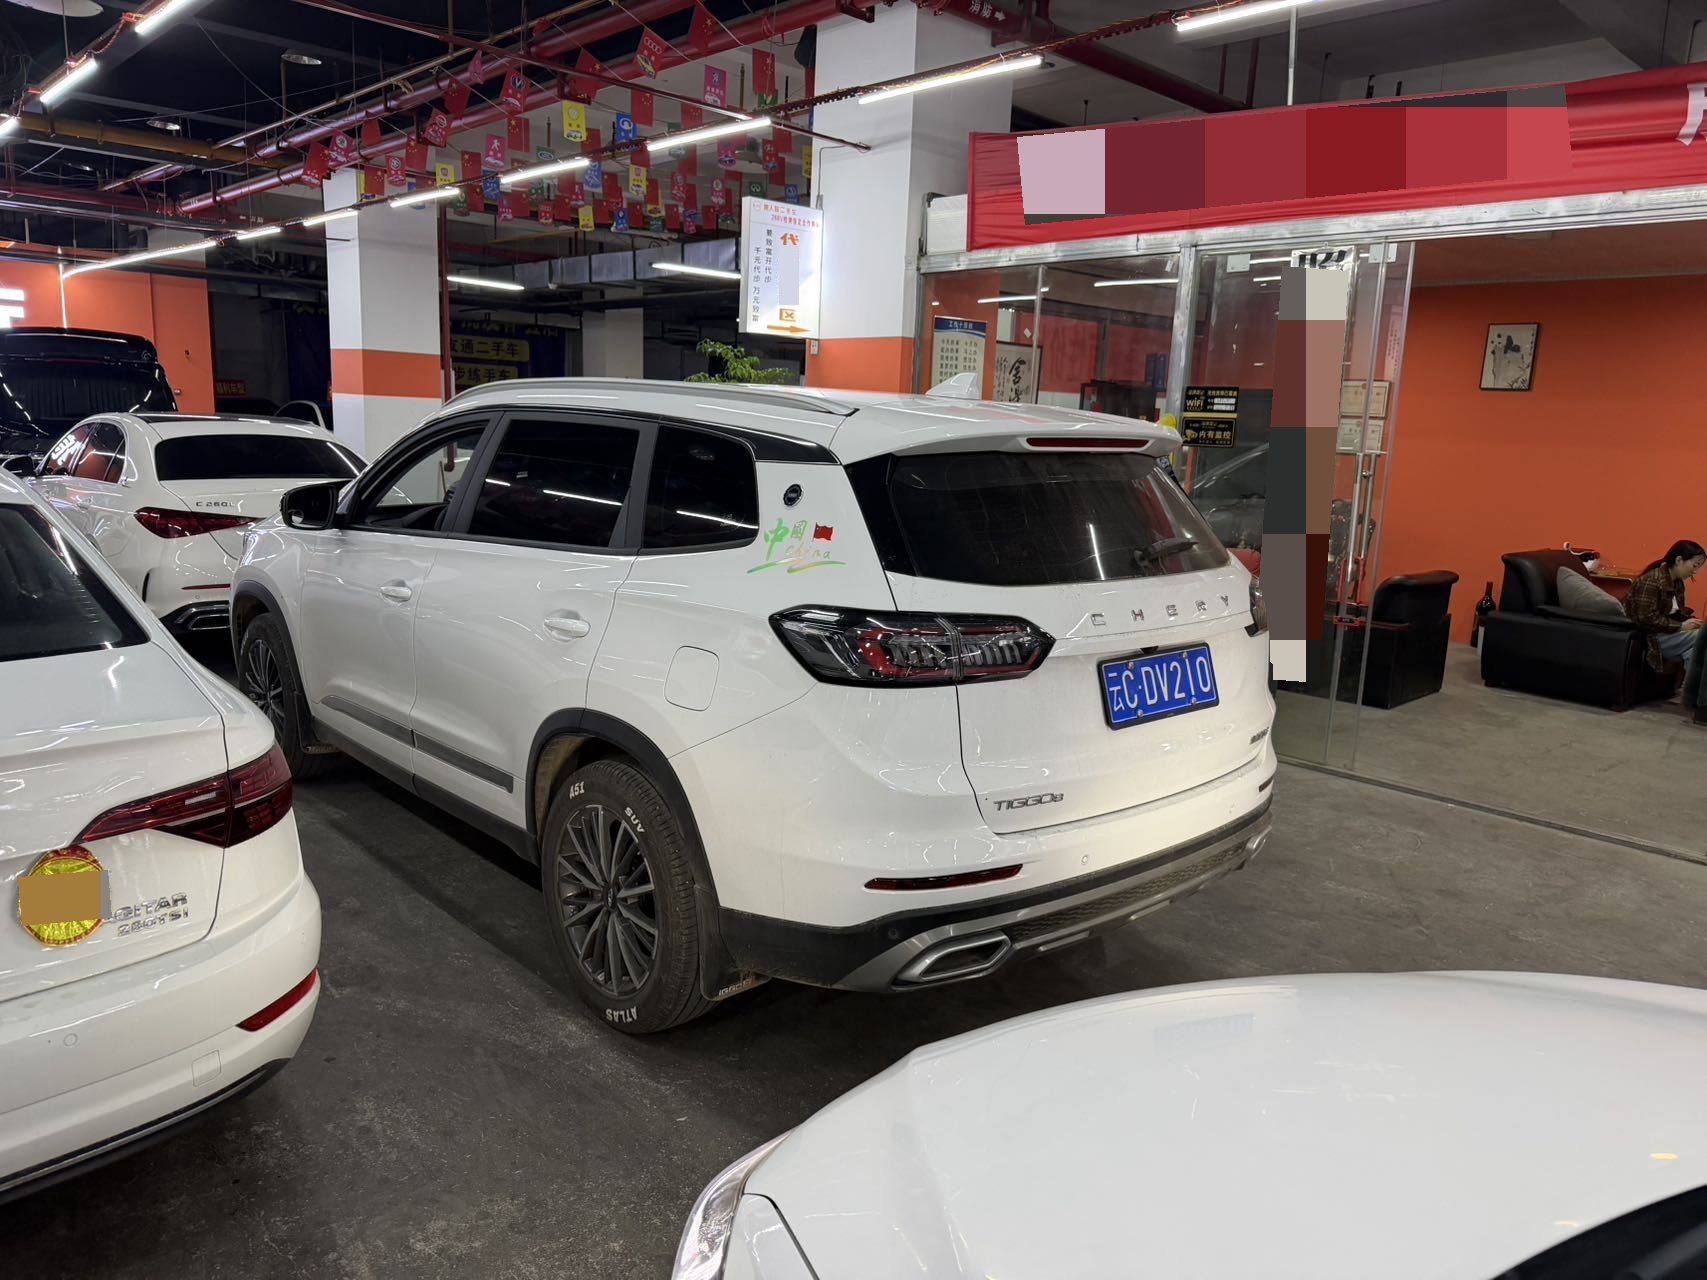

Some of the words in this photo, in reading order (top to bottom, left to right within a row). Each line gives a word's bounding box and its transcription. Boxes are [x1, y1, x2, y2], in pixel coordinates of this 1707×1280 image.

[1090, 594, 1230, 627] CHERY
[624, 806, 645, 834] SUV
[606, 1005, 638, 1024] ATLAS
